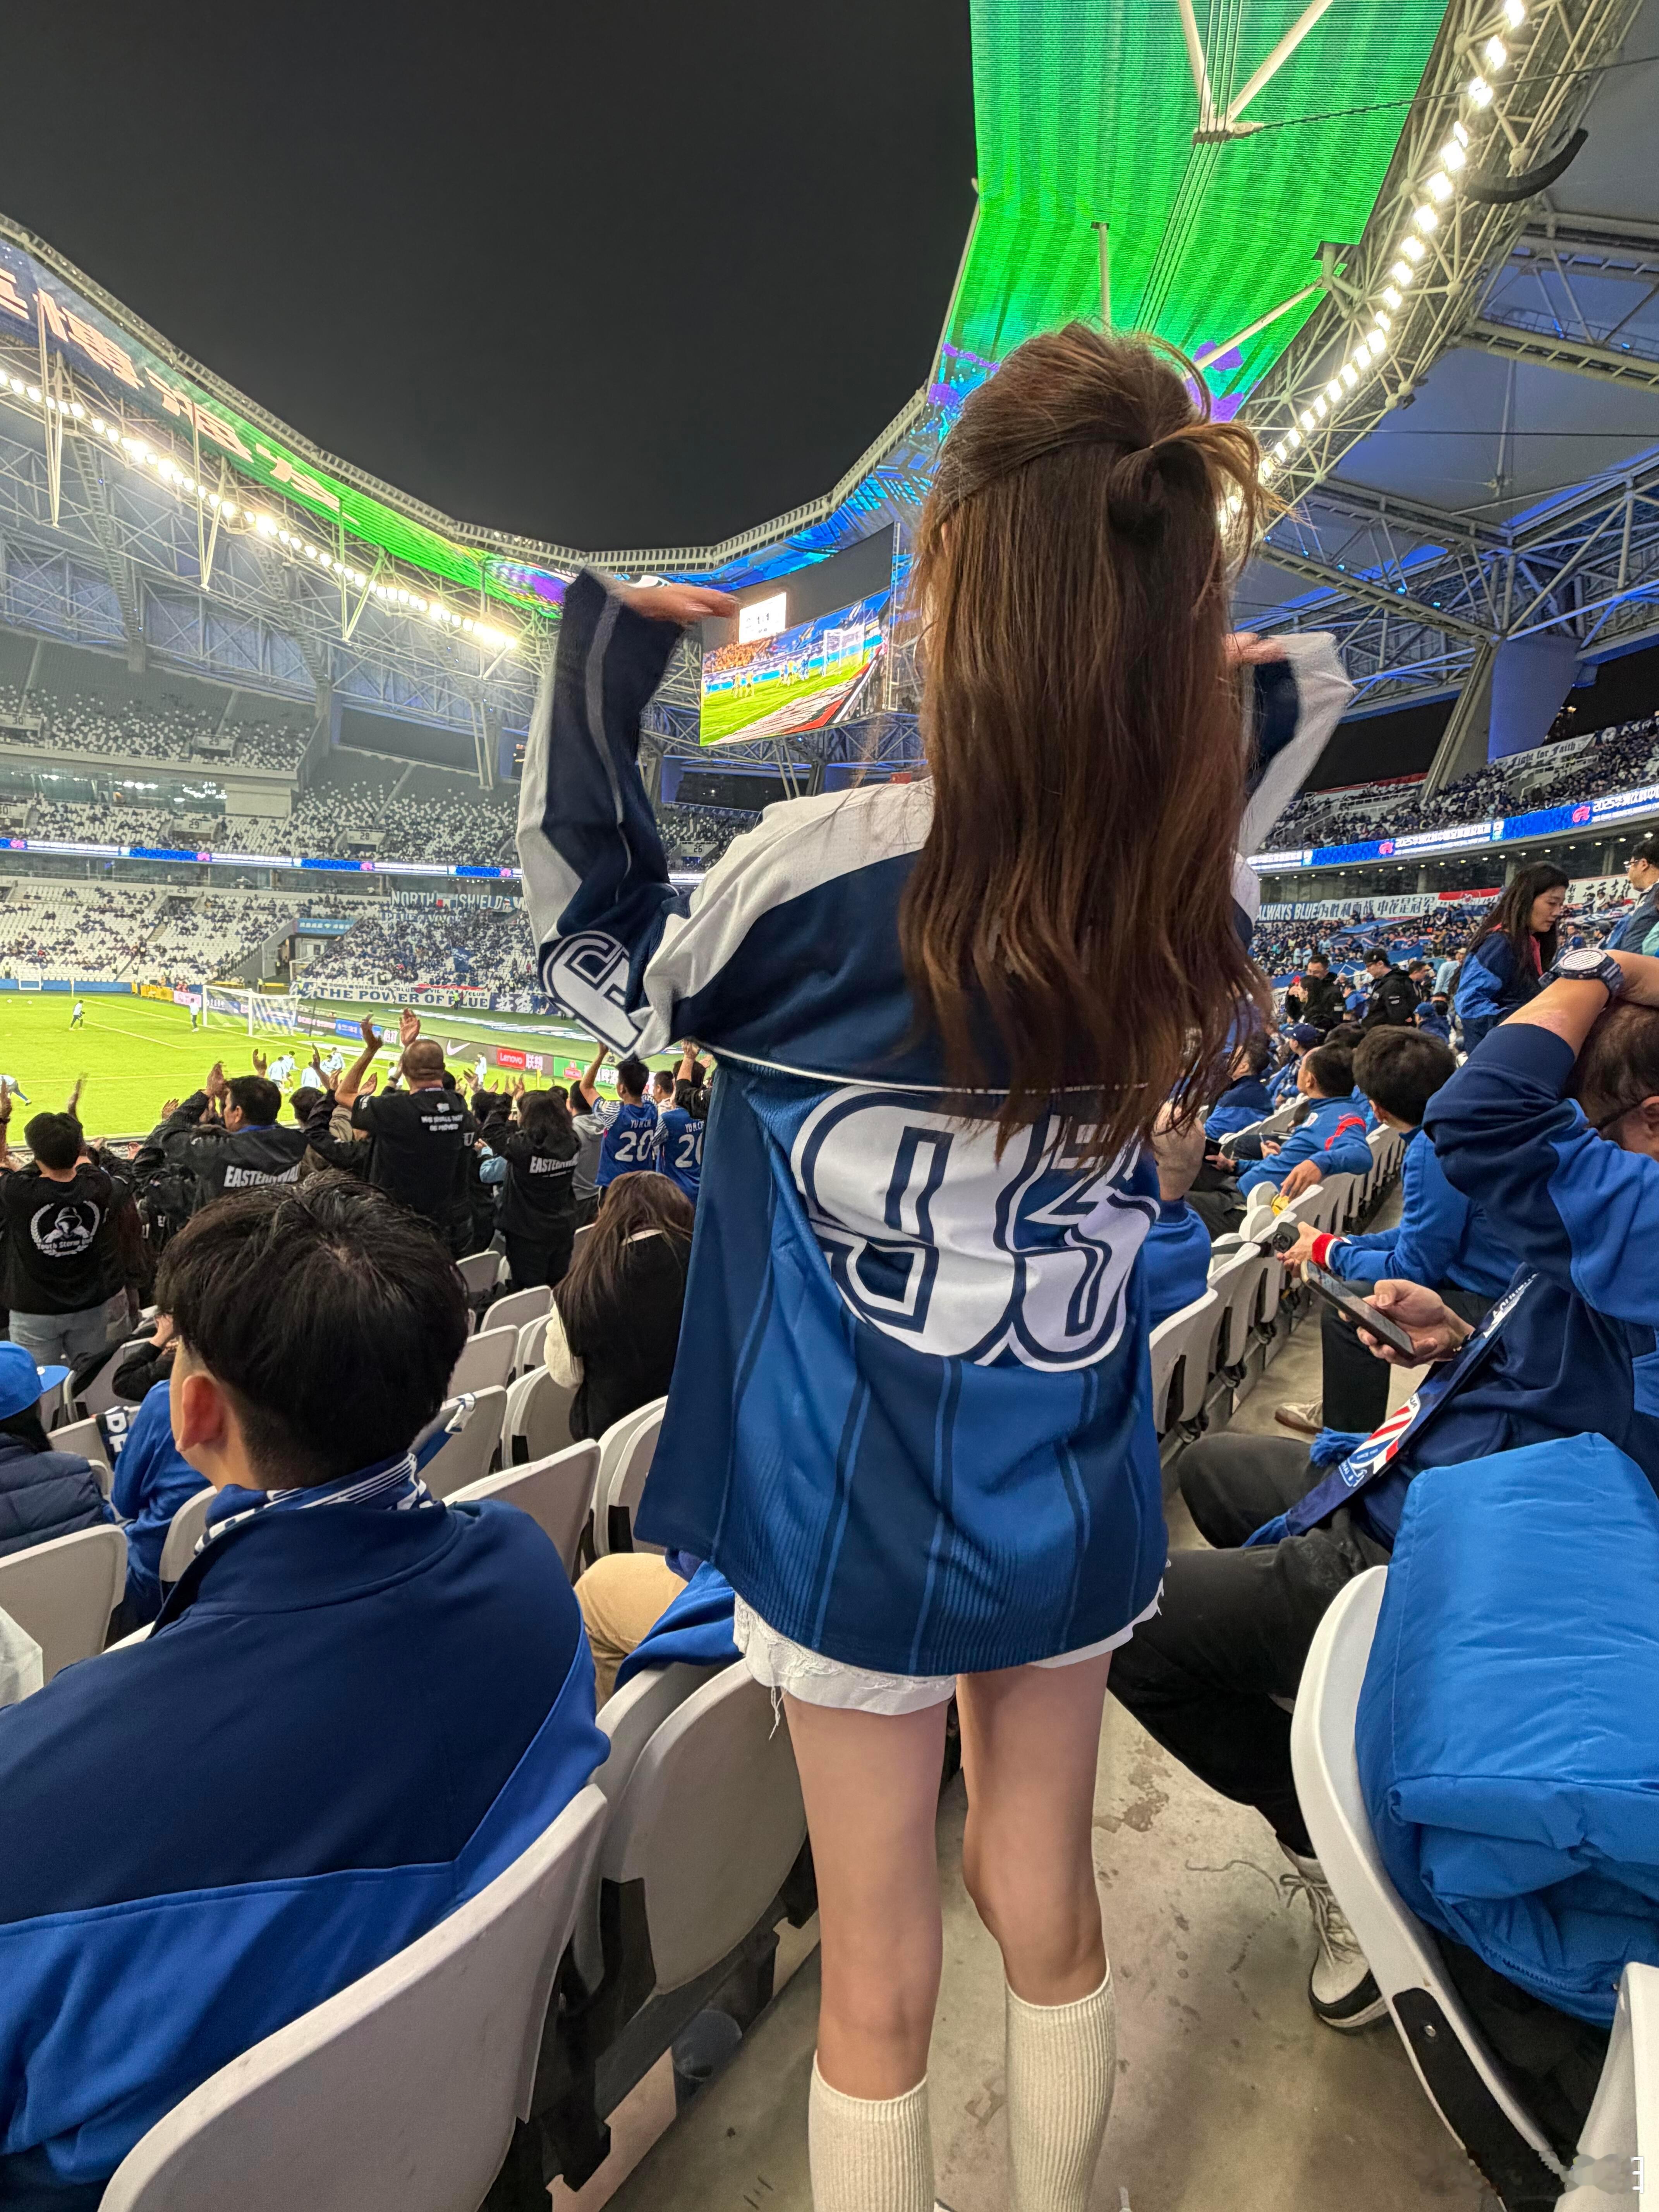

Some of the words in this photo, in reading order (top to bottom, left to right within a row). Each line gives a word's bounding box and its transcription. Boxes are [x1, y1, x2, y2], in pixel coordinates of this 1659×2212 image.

[1537, 750, 1549, 759] for
[1549, 741, 1576, 757] Faith
[189, 820, 199, 829] 29
[360, 832, 369, 840] 28
[391, 891, 434, 907] NORTH
[1377, 896, 1435, 915] 申花是冠军
[1256, 903, 1293, 921] ALWAYS
[1294, 902, 1319, 920] BLUE
[317, 987, 353, 999] THE
[359, 990, 419, 1003] POWER
[424, 994, 445, 1005] OF
[500, 1052, 523, 1064] Lenovo
[615, 1129, 654, 1162] 20
